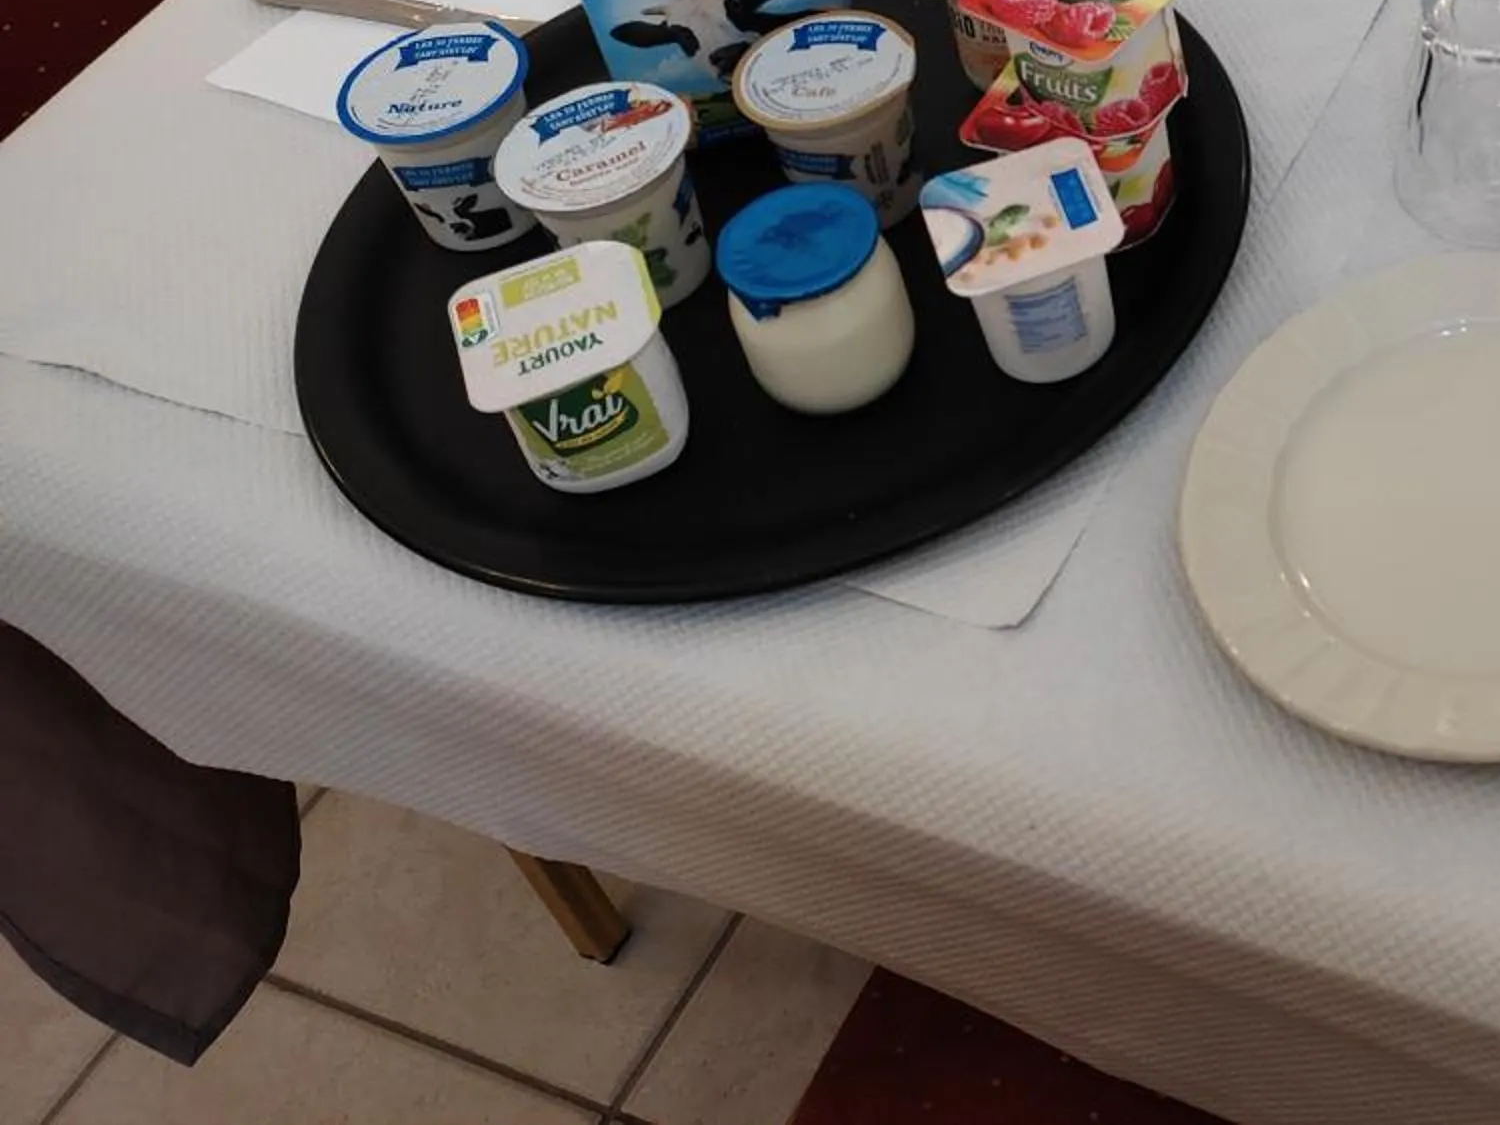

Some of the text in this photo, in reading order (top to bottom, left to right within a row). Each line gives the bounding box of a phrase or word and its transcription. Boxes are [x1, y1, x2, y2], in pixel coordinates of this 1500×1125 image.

[1020, 59, 1098, 103] Fruits
[387, 99, 463, 115] Nature
[556, 140, 648, 182] Caramel
[491, 299, 618, 368] NATURE
[517, 331, 604, 377] YAOURT
[533, 389, 624, 443] Vrai
